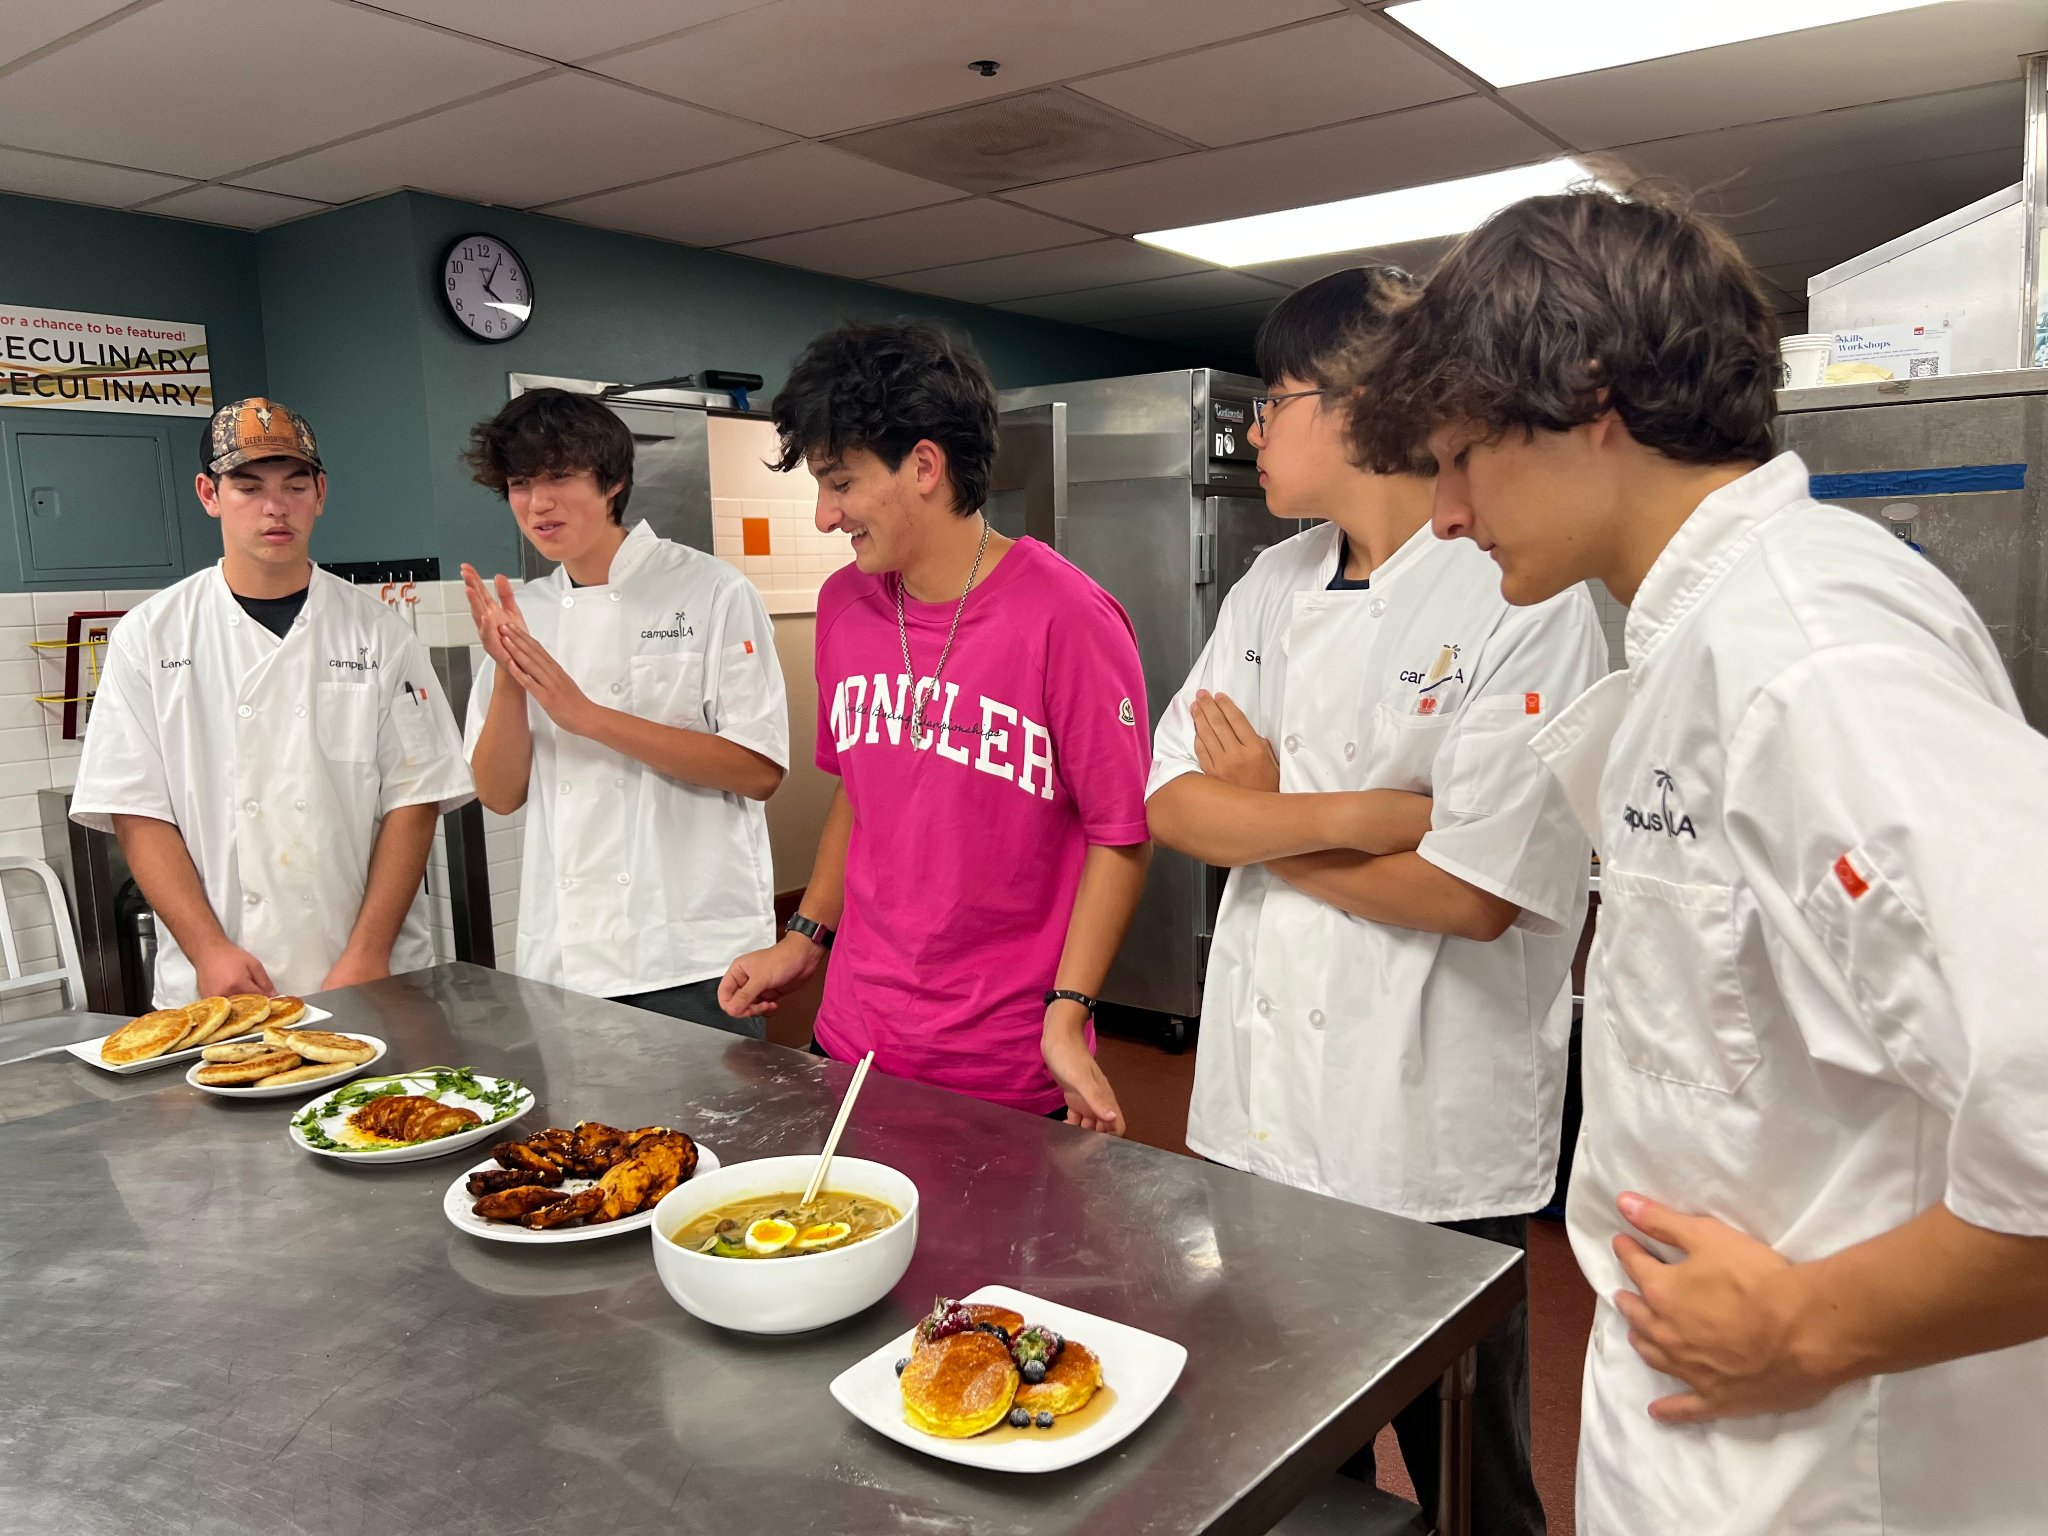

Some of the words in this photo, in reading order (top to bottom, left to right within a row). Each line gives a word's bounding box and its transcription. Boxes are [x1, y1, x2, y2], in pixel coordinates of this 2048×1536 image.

[463, 247, 474, 261] 11
[477, 244, 490, 258] 12
[451, 260, 463, 274] 10
[510, 268, 517, 281] 2
[448, 277, 456, 291] 9
[516, 288, 523, 301] 3
[455, 298, 463, 311] 8
[469, 313, 475, 327] 7
[485, 320, 492, 333] 6
[500, 318, 507, 331] 5
[20, 318, 28, 327] a
[33, 317, 83, 332] chance
[88, 322, 101, 333] to
[106, 324, 123, 336] be
[127, 326, 186, 342] featured!
[1839, 341, 1891, 351] Workshops
[0, 334, 197, 373] ECULINARY
[90, 635, 107, 643] ICE
[641, 629, 679, 640] campus
[682, 626, 694, 637] LA
[365, 660, 379, 670] LA
[872, 704, 912, 730] Boxing
